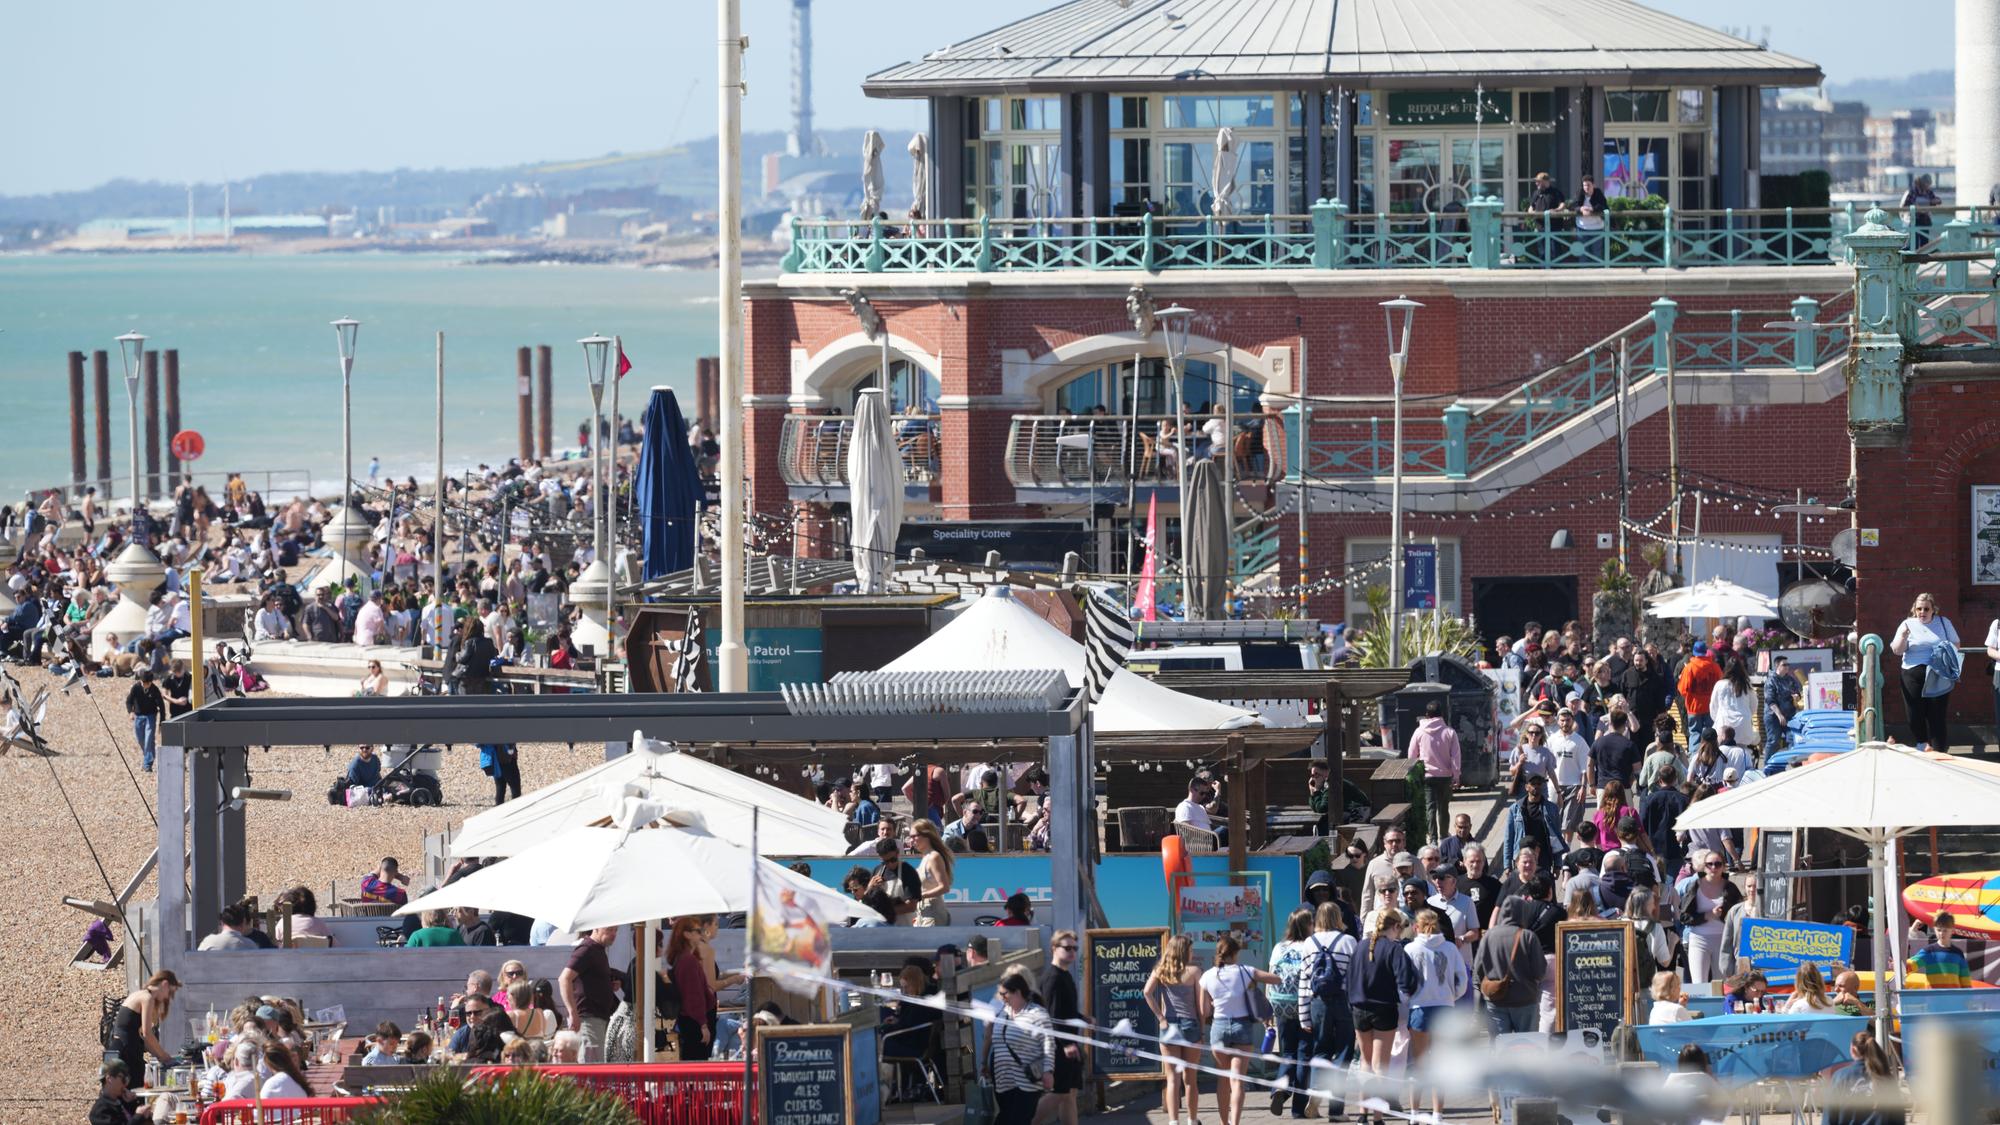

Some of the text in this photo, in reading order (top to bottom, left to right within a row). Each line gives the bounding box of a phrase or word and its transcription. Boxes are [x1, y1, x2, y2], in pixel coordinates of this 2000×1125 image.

[1407, 104, 1450, 114] RIDDLE
[933, 529, 979, 541] Speciality
[753, 645, 790, 656] Patrol
[1750, 925, 1842, 947] BRIGHTON
[1750, 939, 1841, 957] WATERSPORTS
[1108, 960, 1140, 972] SALADS
[773, 1070, 814, 1084] DRAUGHT
[794, 1084, 821, 1097] ALES
[784, 1099, 823, 1112] CIDERS
